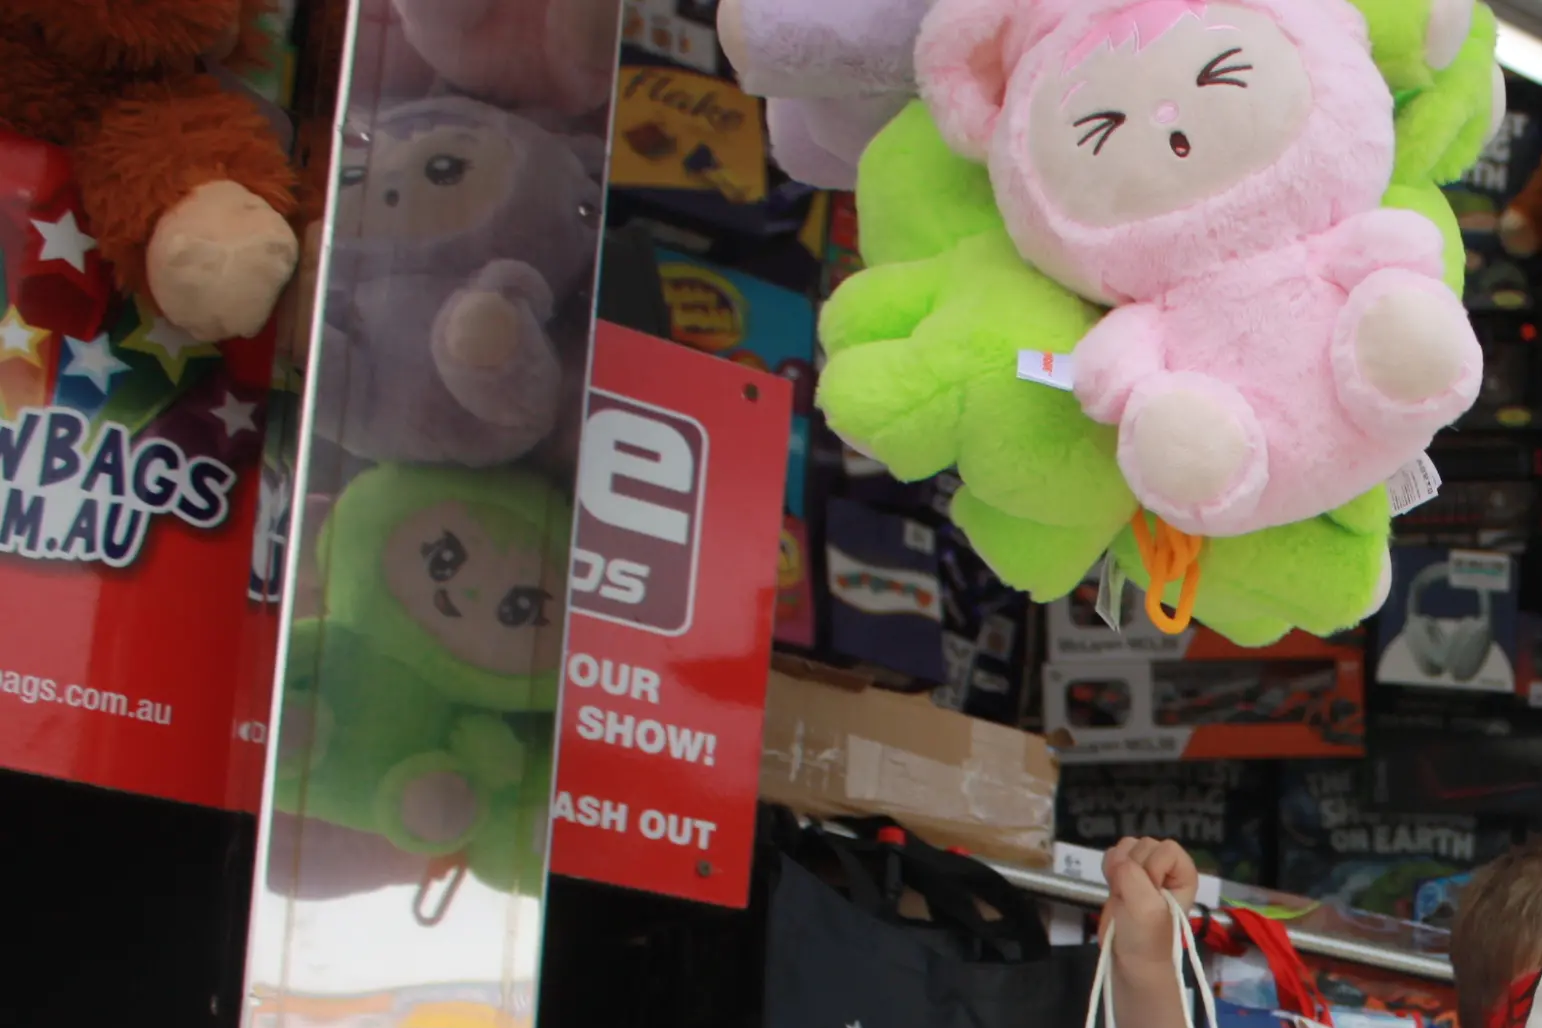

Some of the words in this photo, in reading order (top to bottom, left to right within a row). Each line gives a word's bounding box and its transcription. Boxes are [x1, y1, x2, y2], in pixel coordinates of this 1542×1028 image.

[622, 66, 746, 132] Flake
[0, 668, 173, 726] ags.com.au
[567, 653, 660, 703] OUR
[577, 706, 717, 766] SHOW!
[639, 808, 717, 850] OUT
